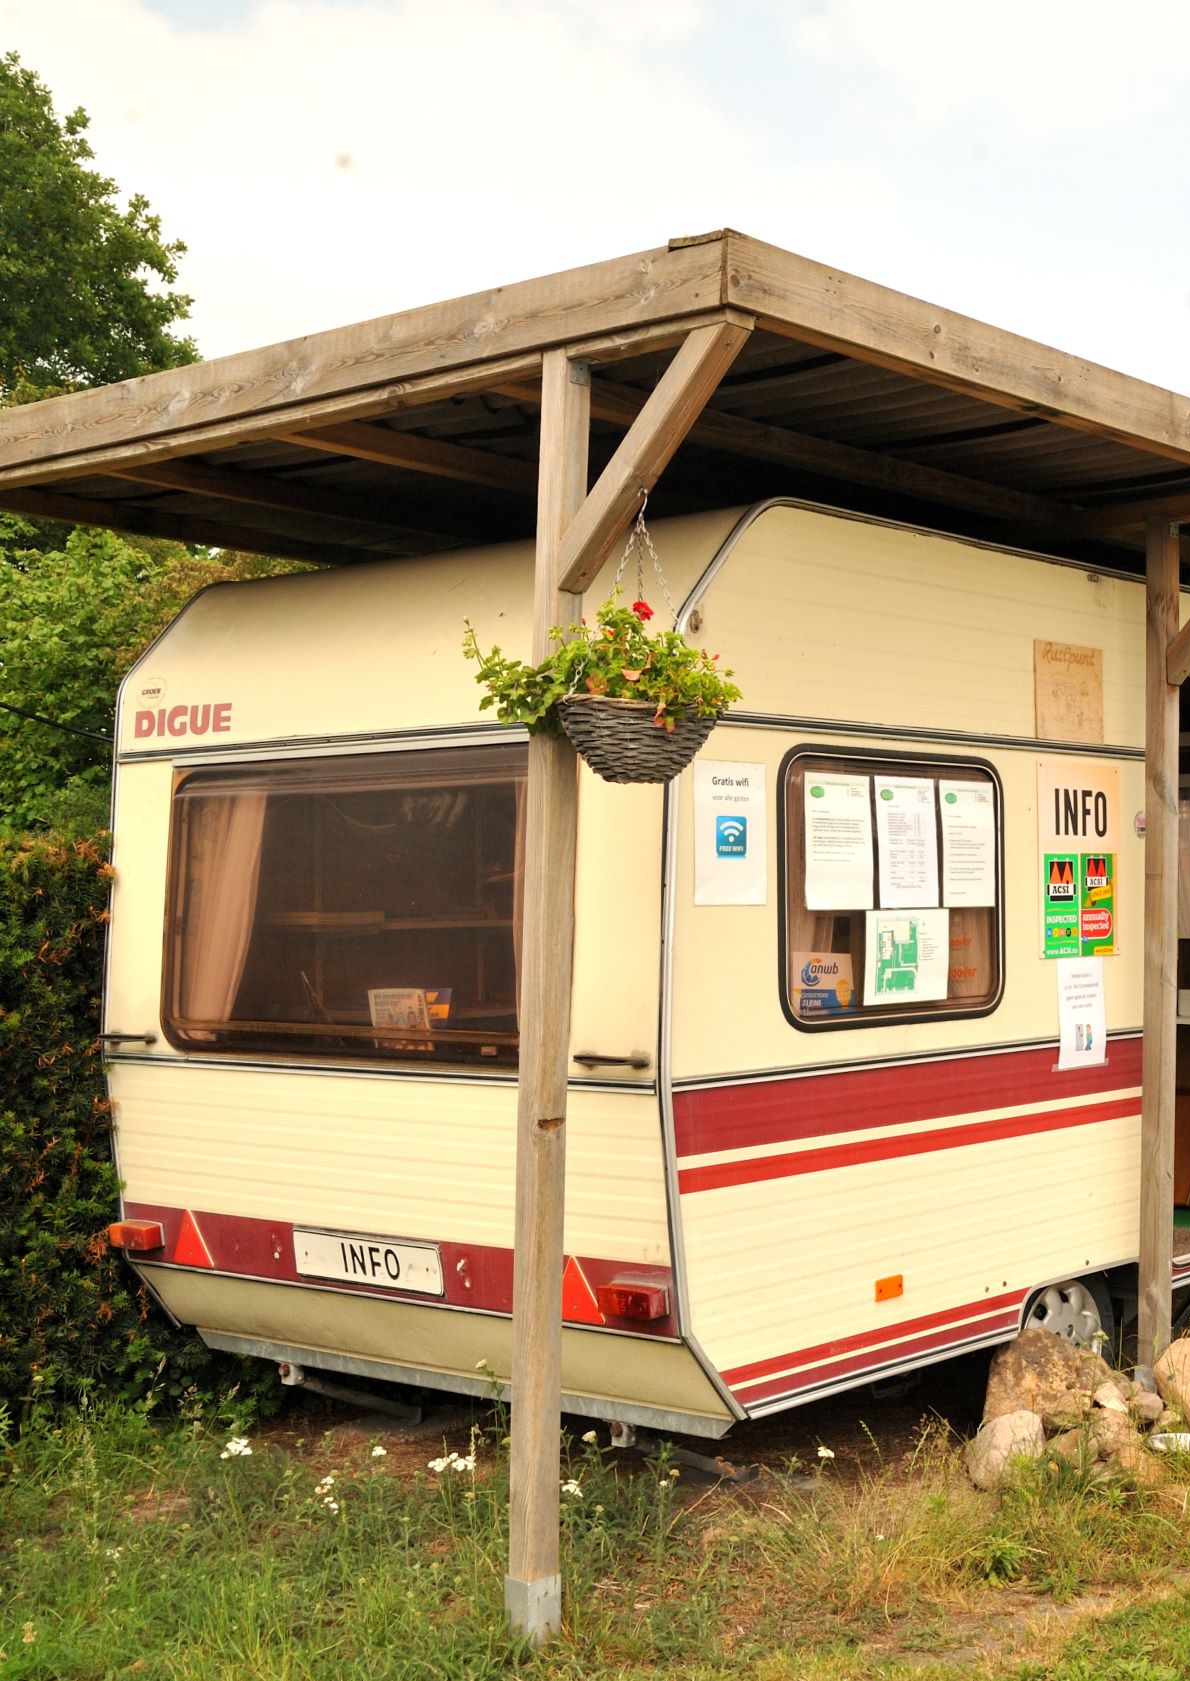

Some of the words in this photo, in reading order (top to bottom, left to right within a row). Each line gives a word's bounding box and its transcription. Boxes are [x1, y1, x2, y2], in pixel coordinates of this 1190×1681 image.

[134, 703, 232, 738] DIGUE
[712, 776, 734, 786] Gratis
[735, 777, 749, 787] wifi
[1054, 788, 1108, 838] INFO
[1046, 914, 1077, 924] INSPECTED
[1082, 911, 1109, 922] annually
[1083, 922, 1109, 931] inspected
[810, 962, 839, 975] anwb
[341, 1242, 400, 1280] INFO
